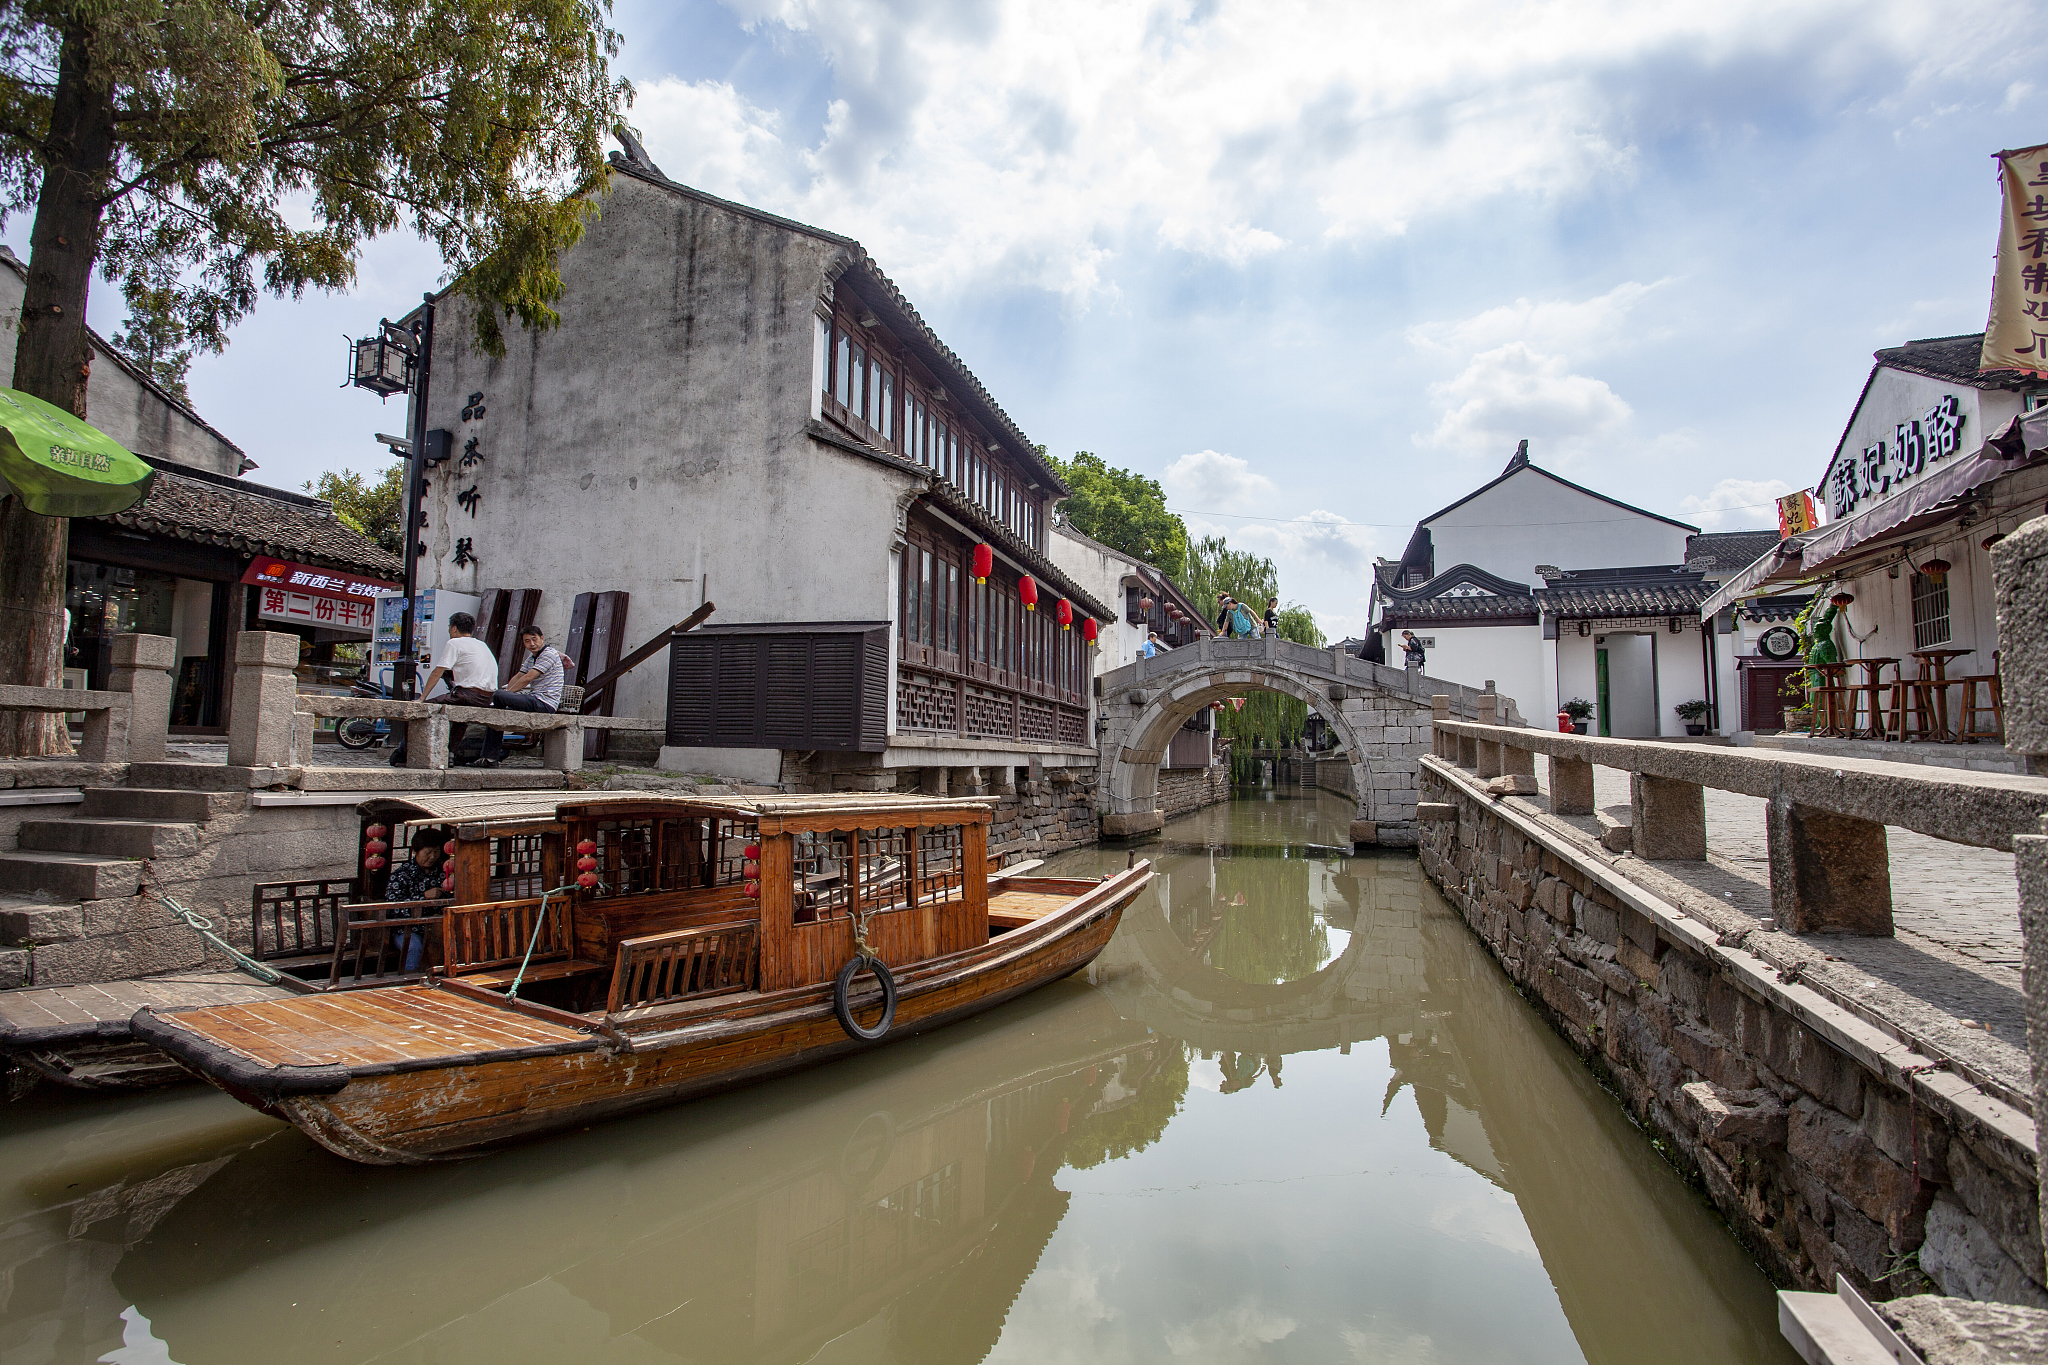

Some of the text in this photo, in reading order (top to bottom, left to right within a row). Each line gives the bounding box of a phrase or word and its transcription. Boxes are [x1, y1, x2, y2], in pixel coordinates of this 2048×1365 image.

[49, 444, 111, 473] 亲近自然
[451, 391, 486, 570] 品茶听琴
[288, 570, 346, 592] 新西兰
[263, 588, 375, 626] 第二份半价
